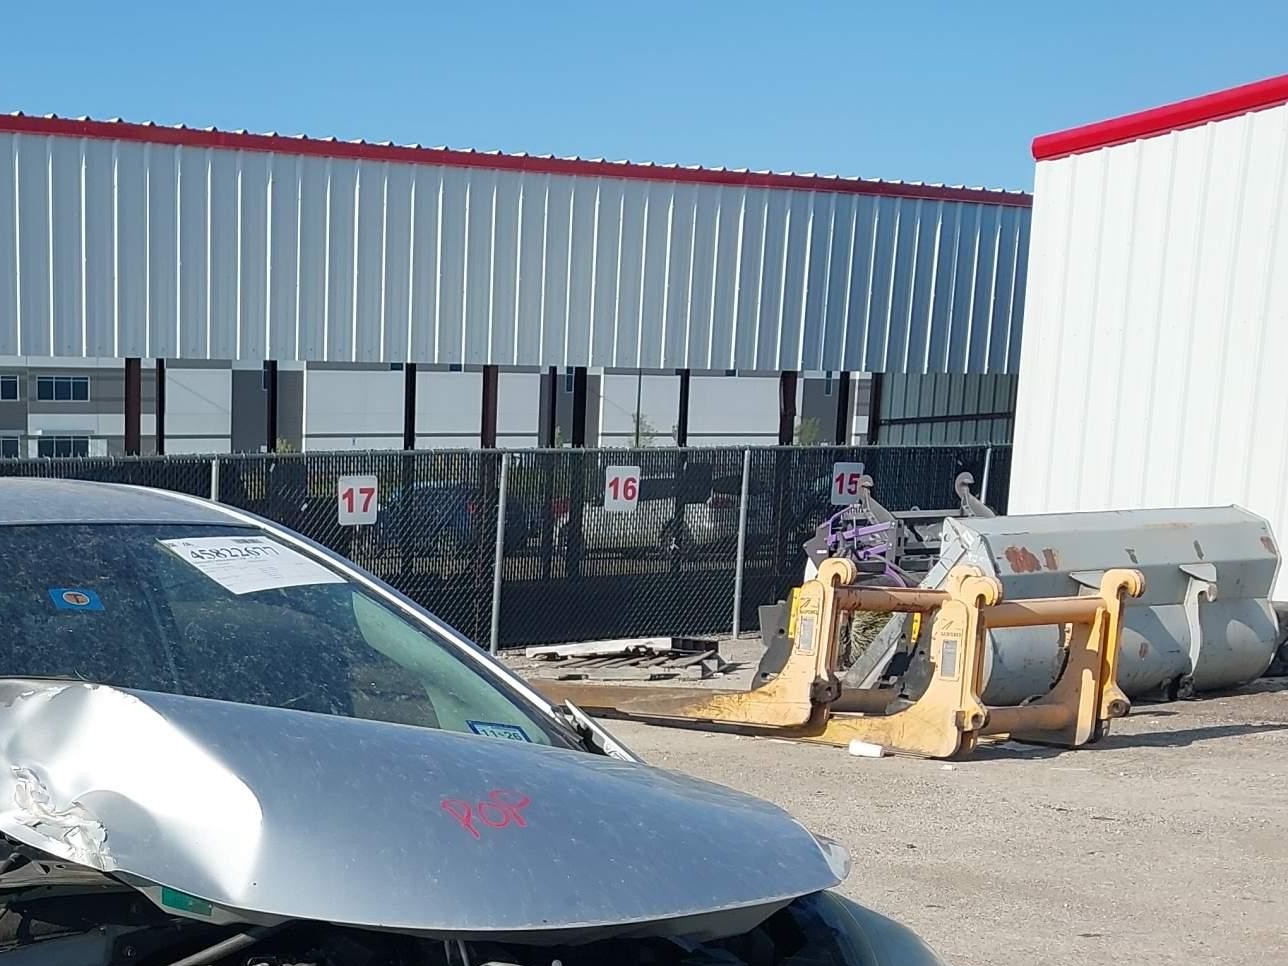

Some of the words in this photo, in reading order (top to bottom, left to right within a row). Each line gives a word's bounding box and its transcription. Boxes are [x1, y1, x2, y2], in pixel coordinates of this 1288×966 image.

[608, 477, 637, 501] 16
[835, 472, 861, 495] 15
[342, 487, 375, 513] 17
[191, 546, 279, 560] 45822677
